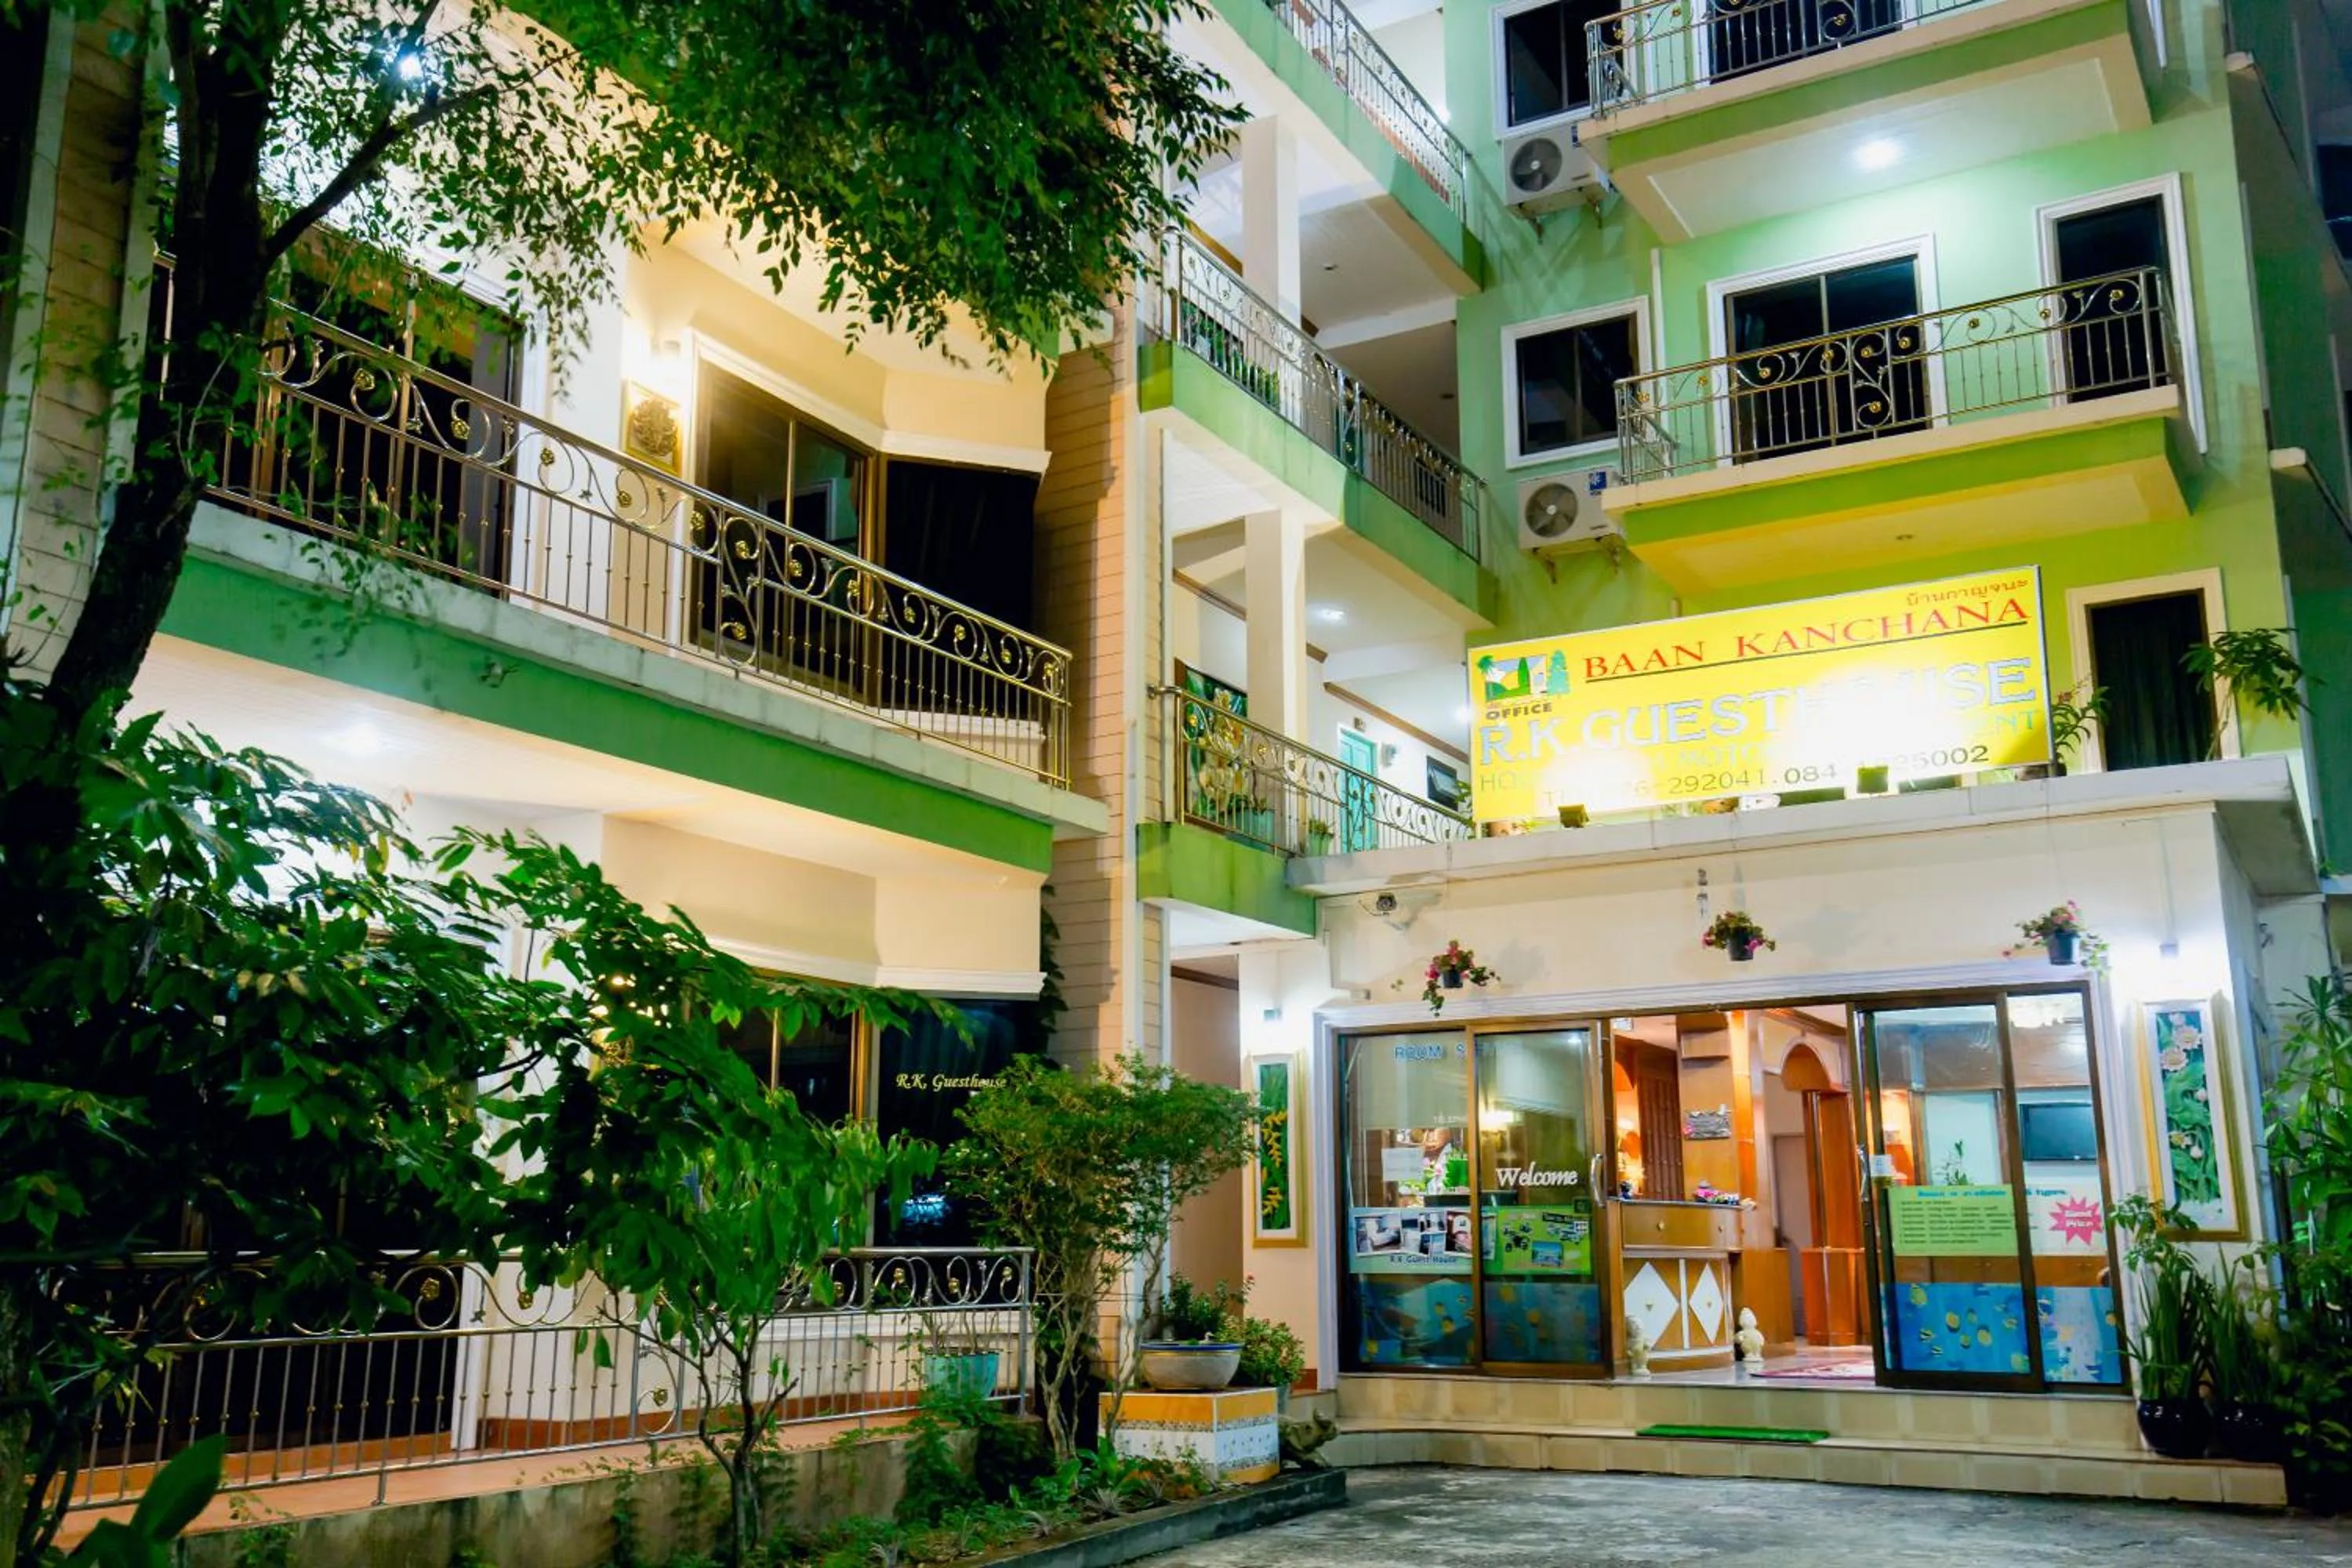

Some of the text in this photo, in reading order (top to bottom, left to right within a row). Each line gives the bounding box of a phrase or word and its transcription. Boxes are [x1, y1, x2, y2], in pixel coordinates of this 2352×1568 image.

[1584, 597, 2032, 679] BAAN KANCHANA
[1486, 702, 1553, 720] OFFICE
[1495, 1161, 1579, 1187] Welcome
